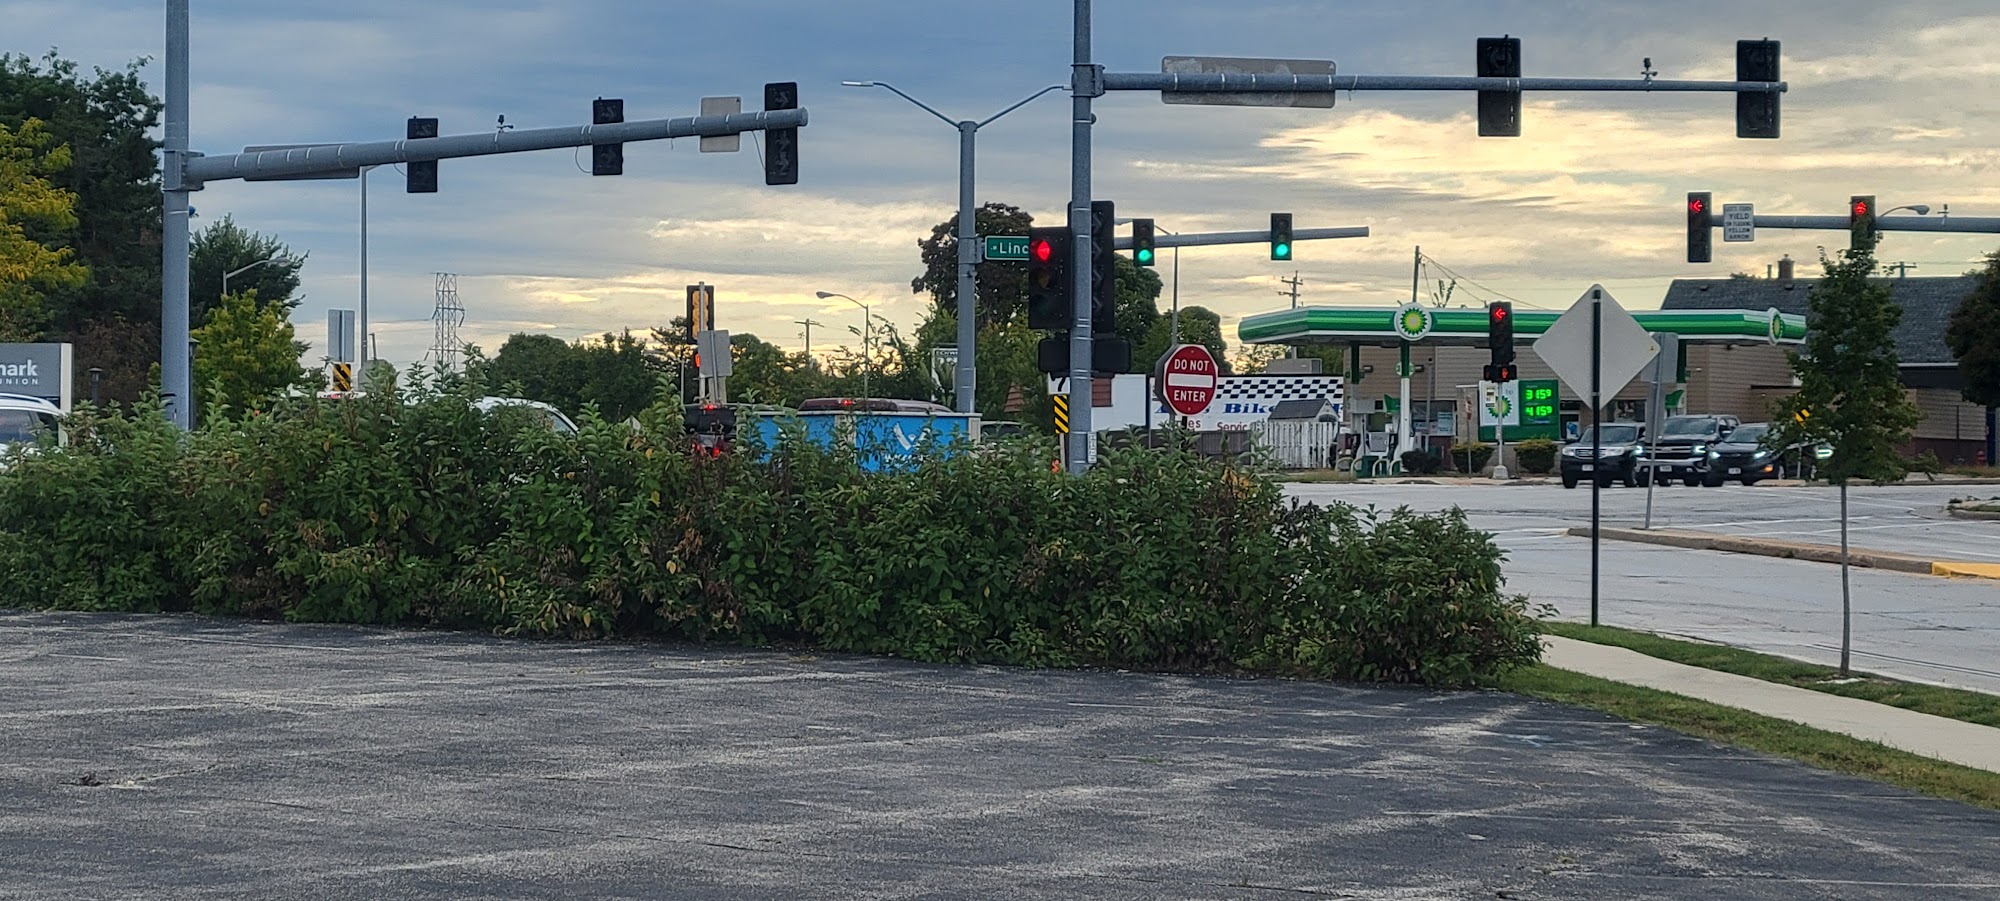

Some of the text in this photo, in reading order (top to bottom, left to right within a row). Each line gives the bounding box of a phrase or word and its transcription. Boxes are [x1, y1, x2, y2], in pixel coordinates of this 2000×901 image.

[1000, 242, 1029, 254] Linc
[1174, 358, 1210, 371] DO NOT
[1174, 390, 1206, 402] ENTER
